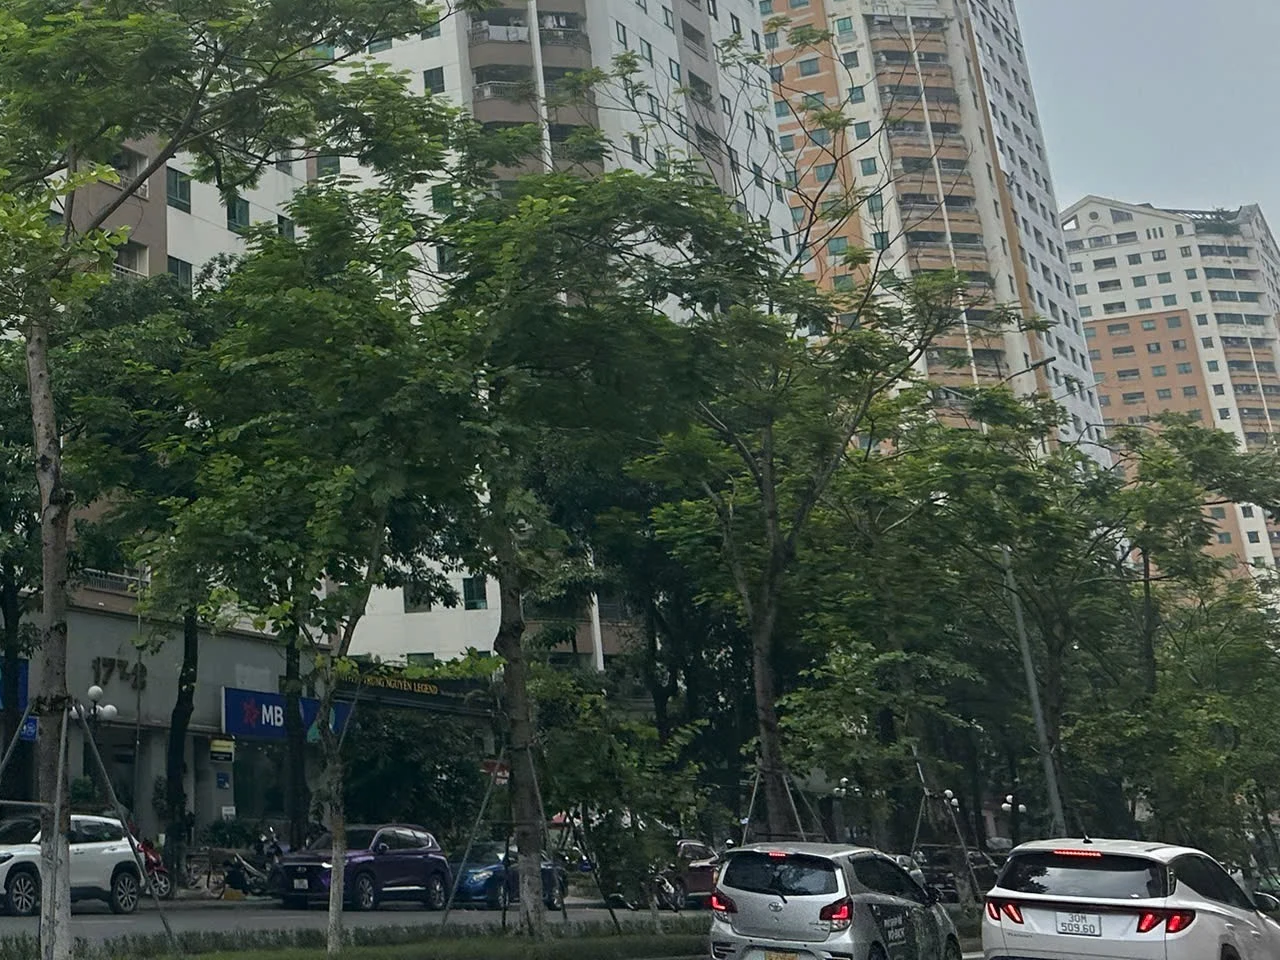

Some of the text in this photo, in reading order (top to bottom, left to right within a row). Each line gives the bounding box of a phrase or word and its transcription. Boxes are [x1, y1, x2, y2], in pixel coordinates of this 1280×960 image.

[413, 682, 438, 695] LEGEND
[261, 703, 284, 727] MB
[1061, 923, 1096, 934] 509.60
